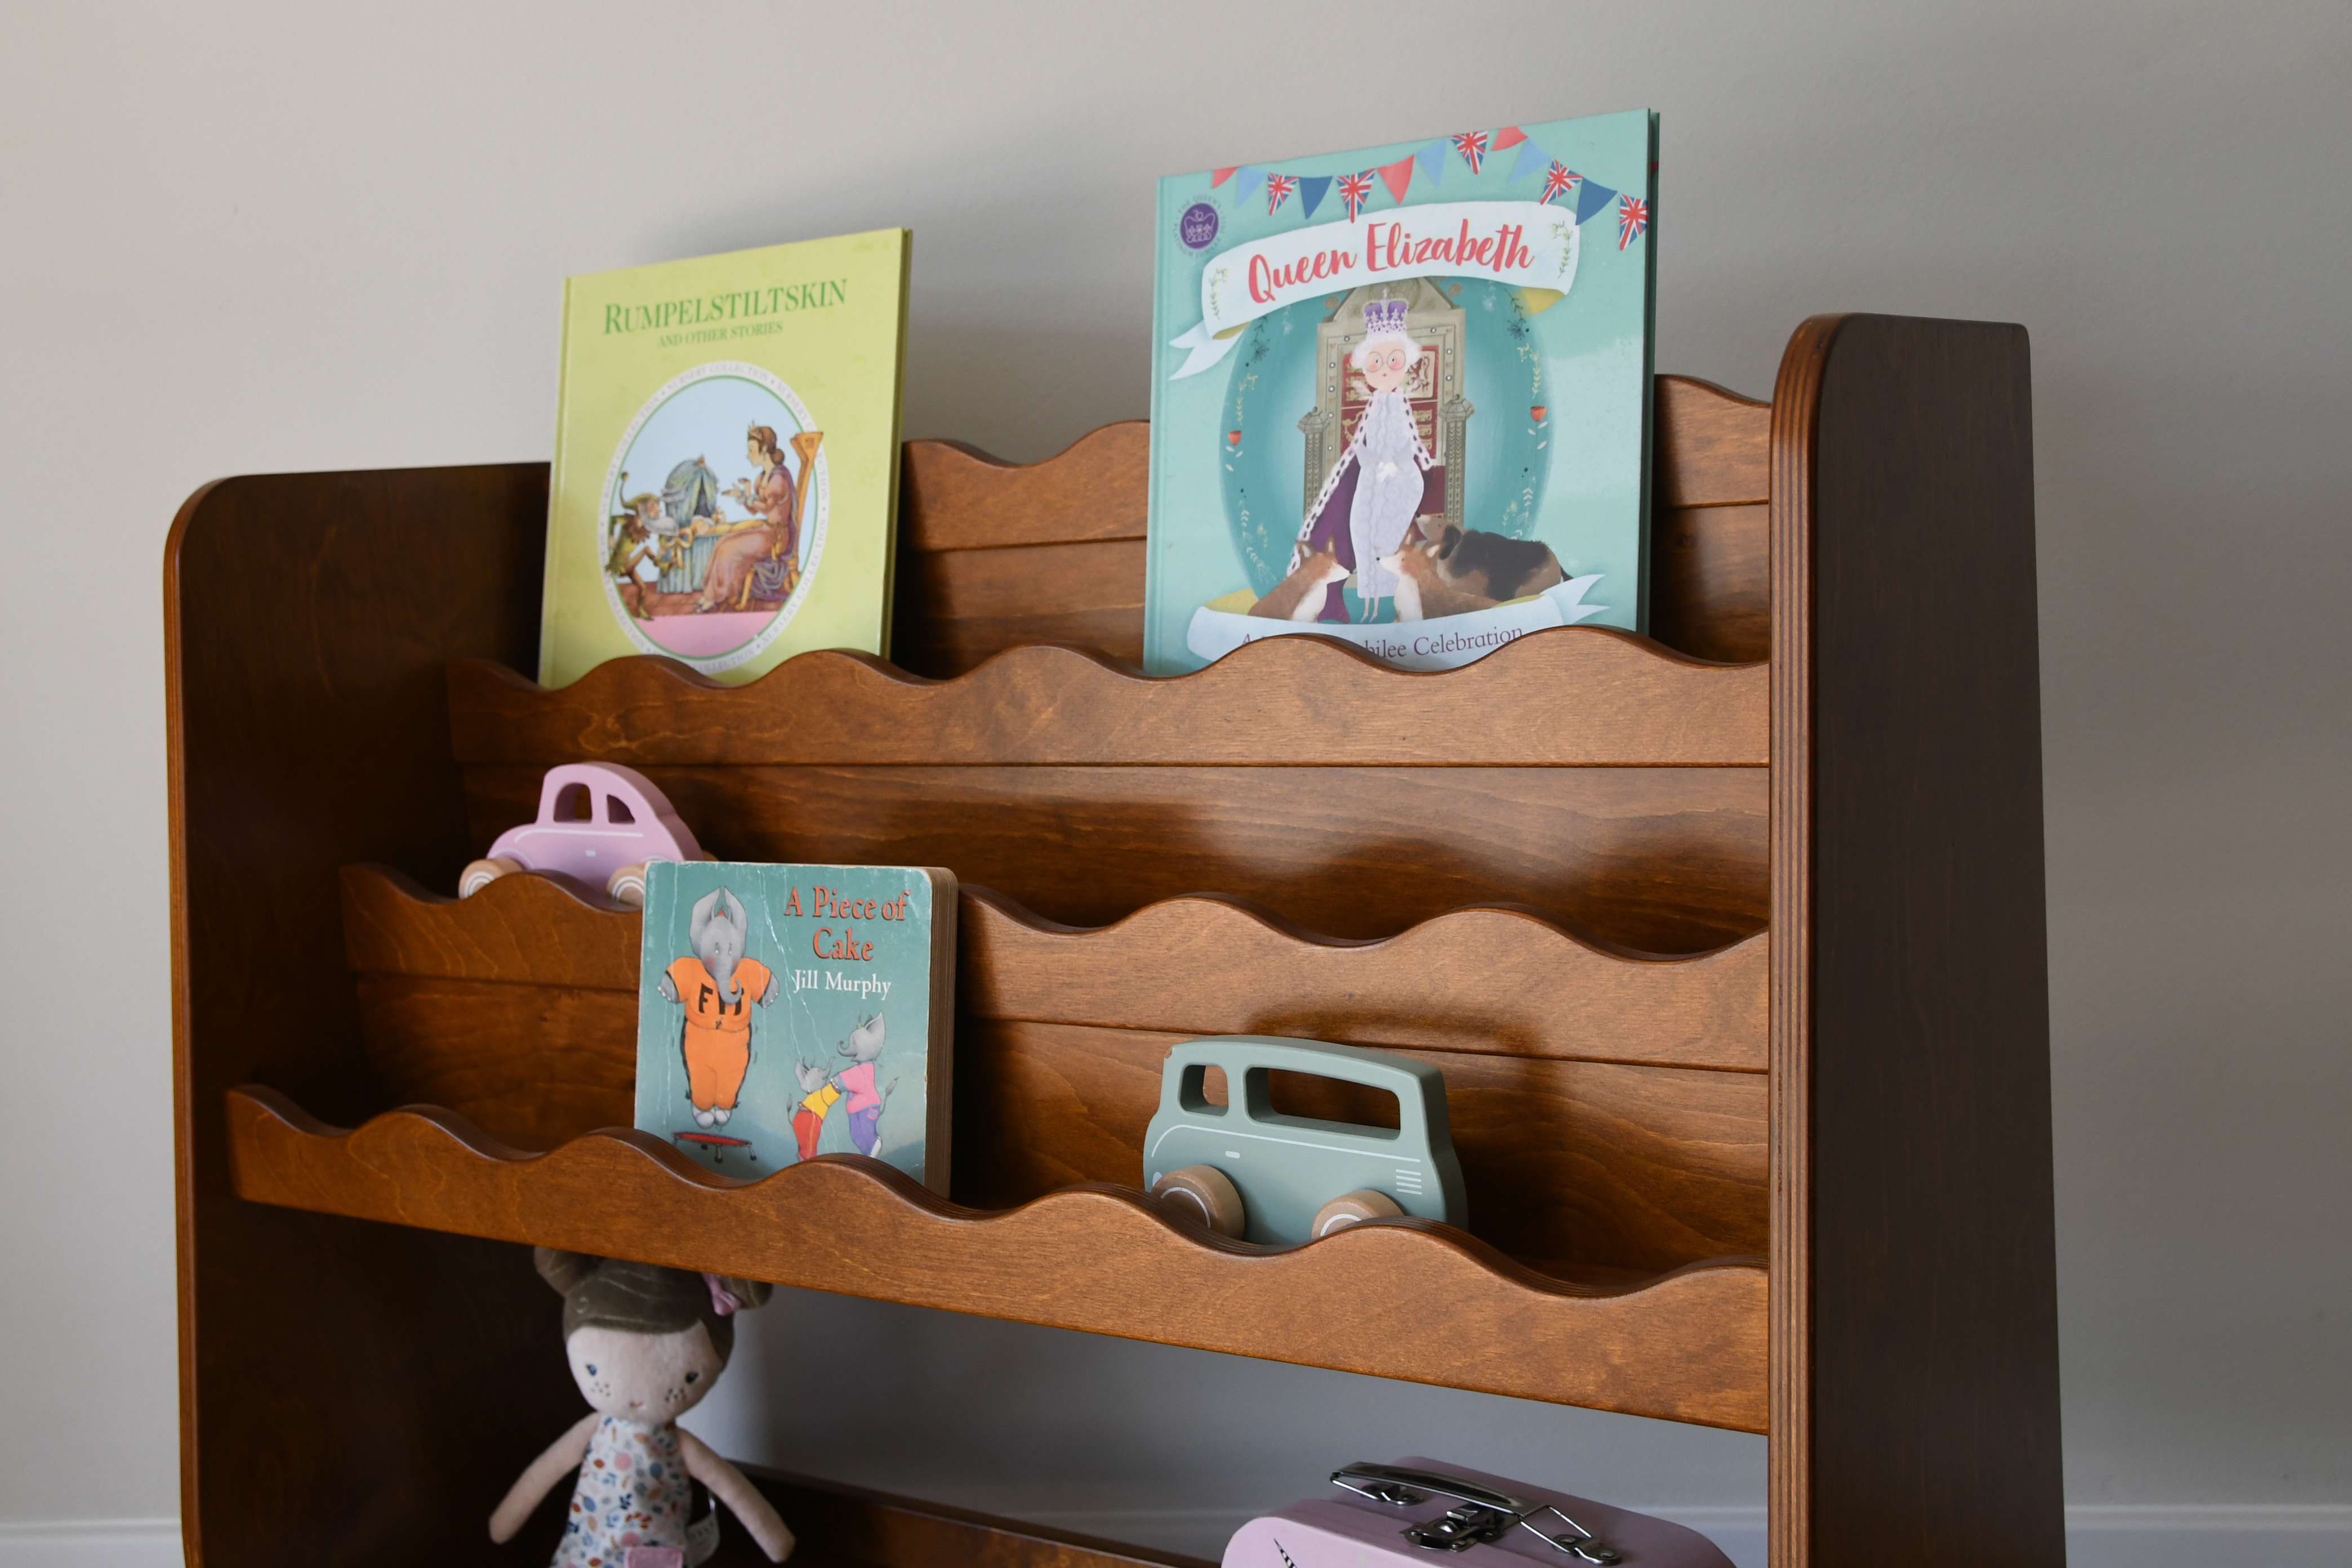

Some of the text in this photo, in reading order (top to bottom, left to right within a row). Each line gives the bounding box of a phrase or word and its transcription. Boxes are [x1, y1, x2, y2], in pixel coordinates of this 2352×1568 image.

[1248, 219, 1535, 304] Queen Elizabeth
[604, 279, 848, 335] RUMPELSTILTSKIN
[658, 321, 784, 348] AND OTHER STORIES
[1364, 639, 1407, 658] bilee
[1414, 626, 1523, 656] Celebration
[784, 886, 912, 920] A Piece of
[813, 927, 874, 961] Cake
[793, 969, 892, 1001] Jill Murphy
